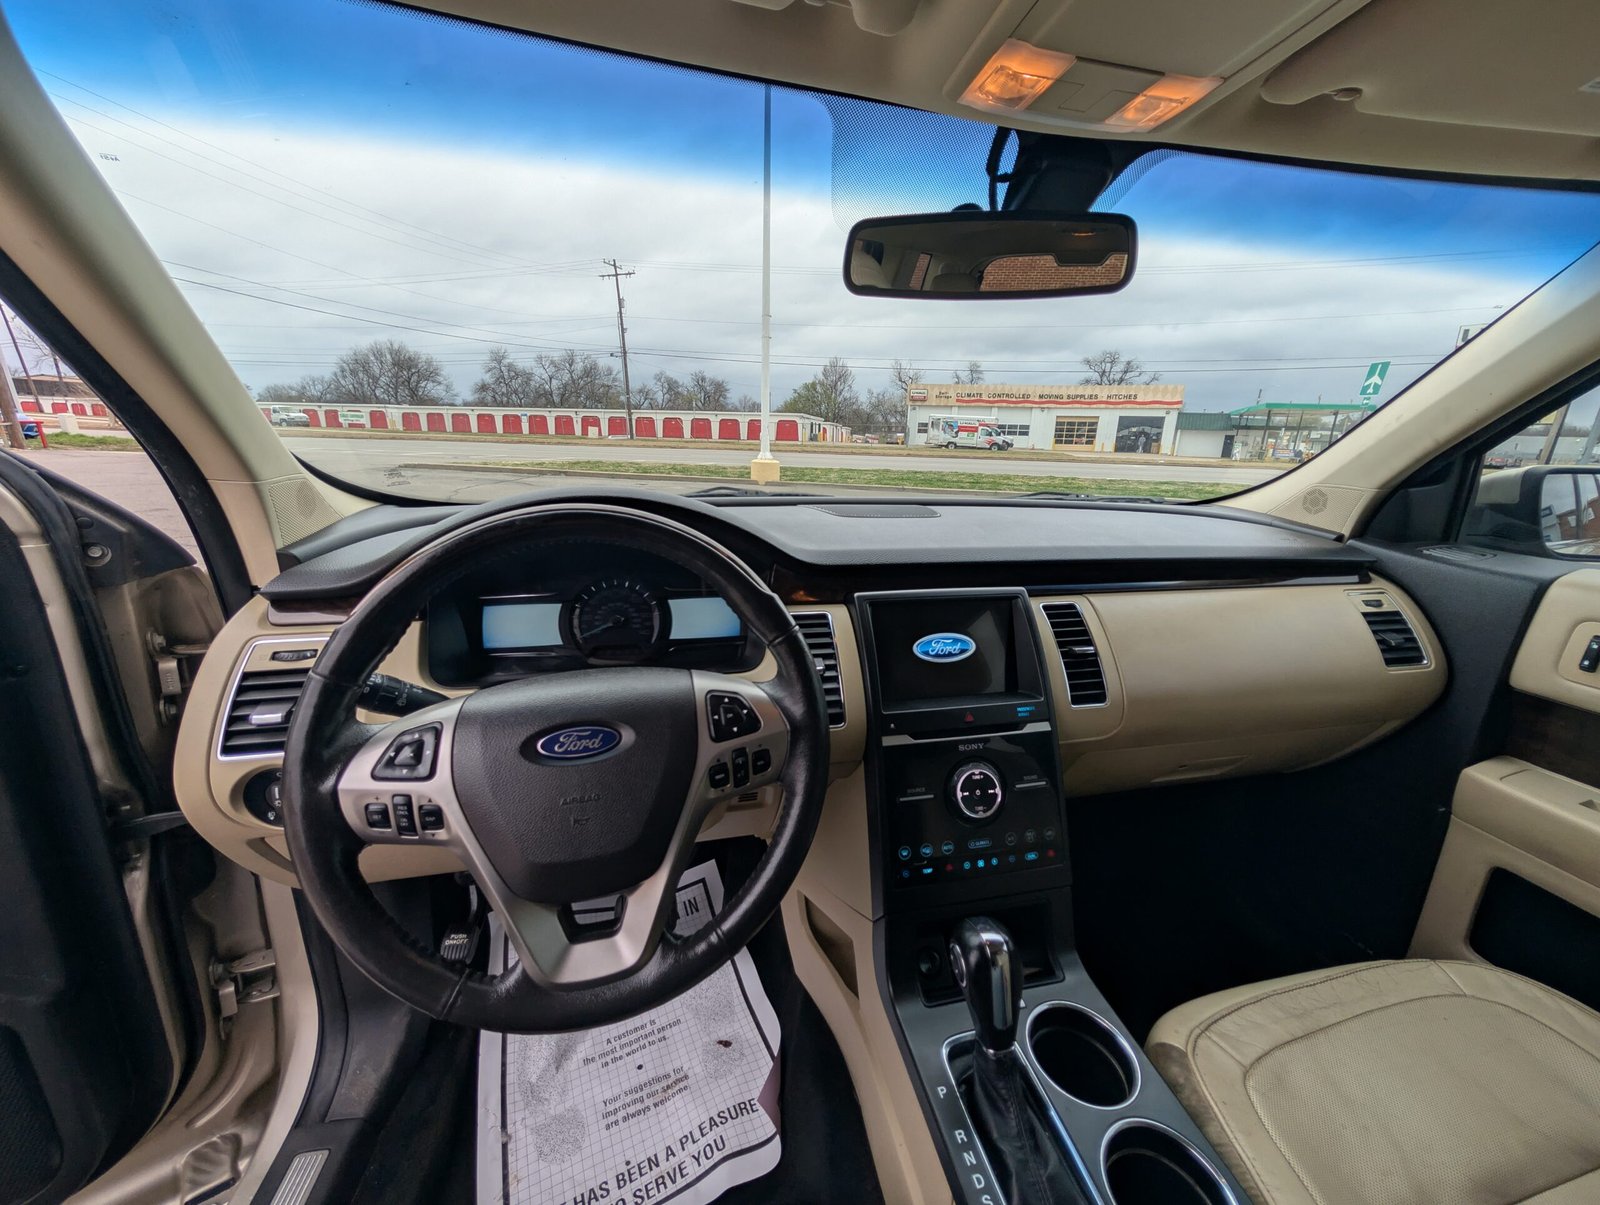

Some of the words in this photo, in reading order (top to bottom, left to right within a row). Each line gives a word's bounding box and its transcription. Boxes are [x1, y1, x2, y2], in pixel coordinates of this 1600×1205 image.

[987, 392, 1031, 400] CONTROLLED
[928, 638, 961, 656] Ford
[554, 730, 603, 753] Ford
[958, 743, 985, 752] SONY
[683, 897, 699, 917] IN
[582, 1056, 596, 1066] the
[598, 1046, 618, 1060] most
[619, 1030, 656, 1051] important
[656, 1019, 682, 1035] person
[606, 1038, 612, 1046] A
[613, 1022, 648, 1042] customer
[610, 1055, 624, 1064] the
[625, 1043, 647, 1058] world
[602, 1093, 622, 1107] Your
[624, 1072, 672, 1097] suggestions
[673, 1065, 684, 1076] for
[937, 1086, 947, 1099] P
[602, 1095, 645, 1120] improving
[646, 1089, 659, 1099] our
[661, 1073, 690, 1093] service
[605, 1119, 620, 1131] are
[622, 1104, 651, 1123] always
[954, 1130, 968, 1144] R
[573, 1181, 611, 1205] HAS
[615, 1153, 660, 1191] BEEN
[665, 1145, 676, 1162] A
[679, 1098, 760, 1152] PLEASURE
[963, 1150, 977, 1167] N
[632, 1161, 690, 1205] SERVE
[691, 1135, 727, 1169] YOU
[972, 1173, 985, 1190] D
[982, 1195, 994, 1205] S
